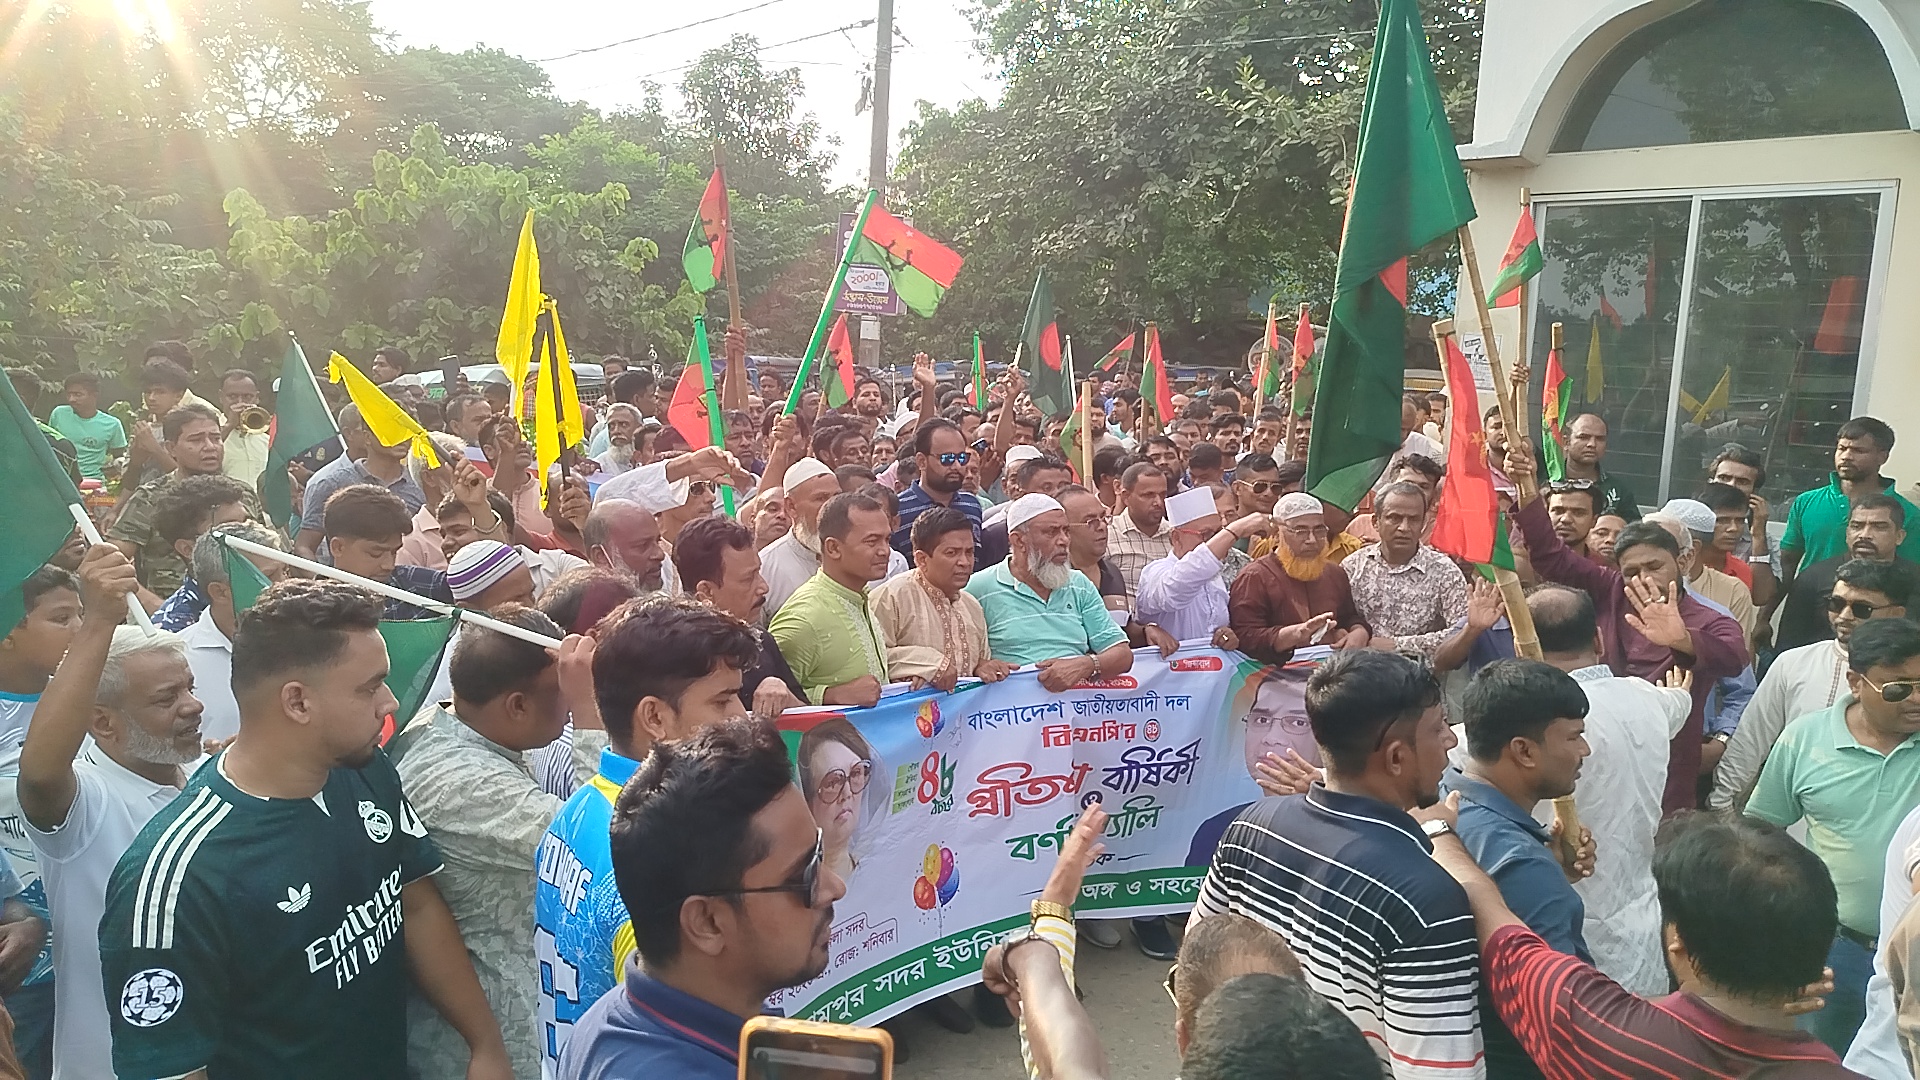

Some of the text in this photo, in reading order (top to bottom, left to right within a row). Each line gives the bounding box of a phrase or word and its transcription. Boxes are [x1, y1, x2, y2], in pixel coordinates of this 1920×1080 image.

[967, 690, 1192, 731] বাংলাদেশ জাতীয়তাবাদী দল
[917, 751, 958, 804] ৪৮
[1101, 738, 1202, 796] বার্ষিকী
[1081, 881, 1119, 898] অঙ্গ
[1126, 880, 1141, 895] ও
[304, 863, 403, 974] Emirate
[845, 918, 866, 937] সদর
[862, 928, 895, 952] শনিবার
[335, 945, 360, 990] FLY
[873, 957, 928, 995] সদর
[134, 985, 169, 1009] 15
